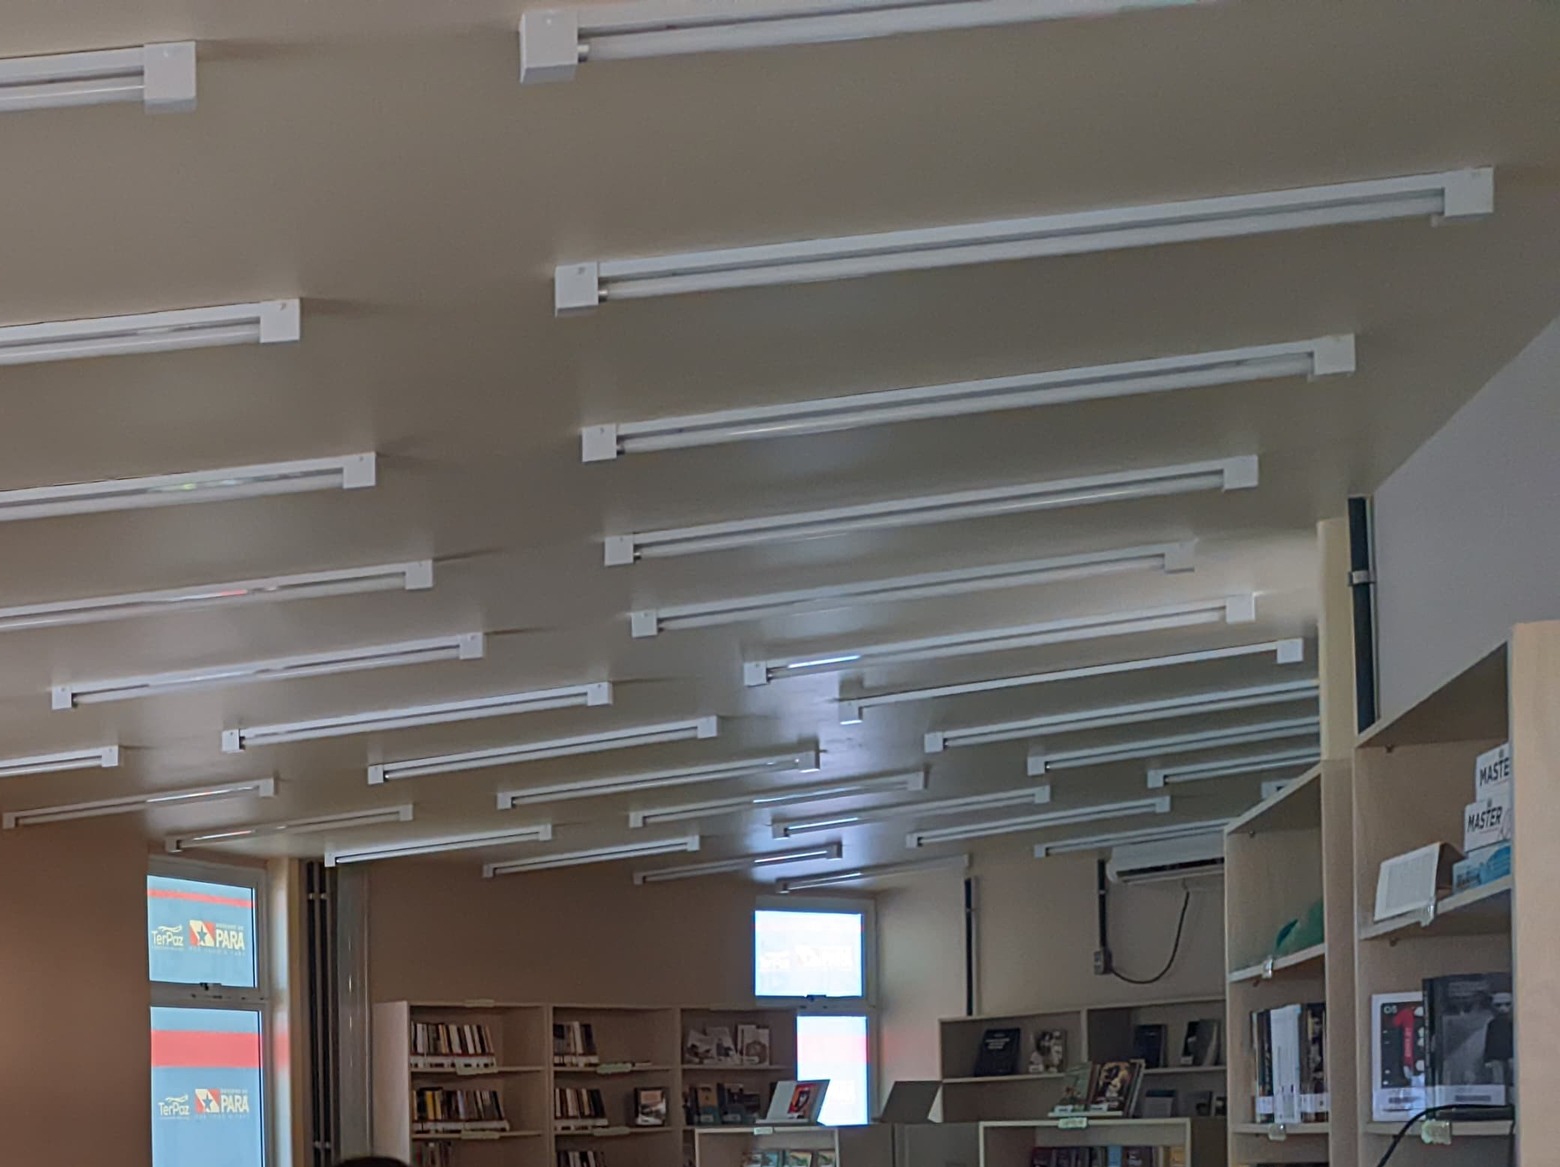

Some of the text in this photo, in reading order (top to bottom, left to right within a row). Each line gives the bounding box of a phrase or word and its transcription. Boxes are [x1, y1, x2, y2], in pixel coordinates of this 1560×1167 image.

[1467, 805, 1503, 832] MASTER
[152, 930, 184, 947] TerPaz
[158, 1102, 190, 1116] TerPaz
